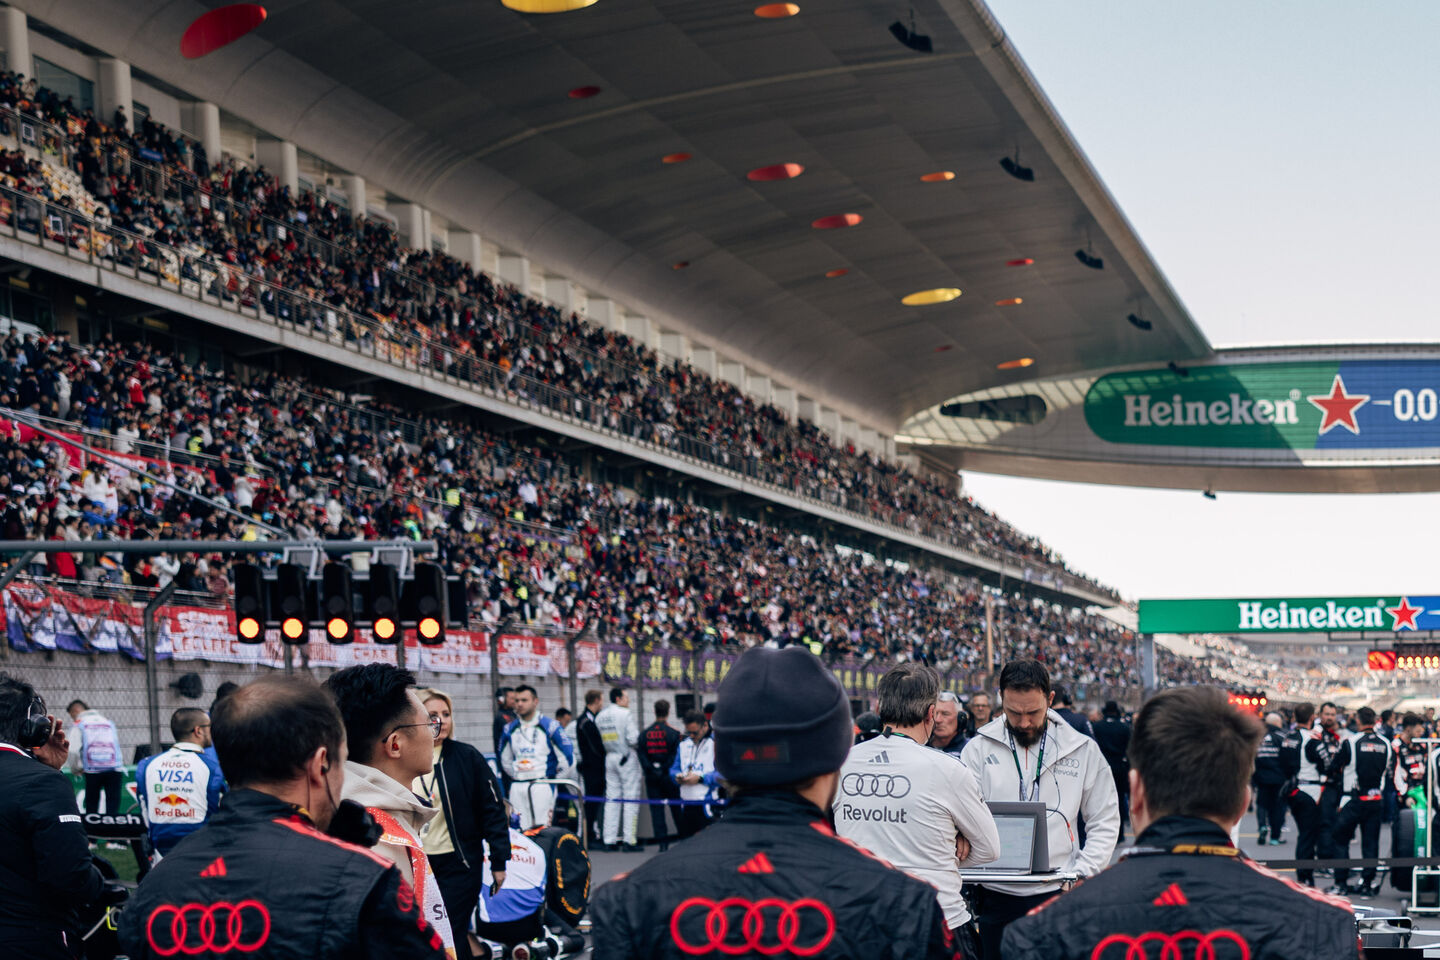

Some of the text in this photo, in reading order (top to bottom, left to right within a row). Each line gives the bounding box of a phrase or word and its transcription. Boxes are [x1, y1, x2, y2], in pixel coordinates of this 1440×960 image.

[1123, 393, 1299, 426] Heineken
[1394, 388, 1438, 422] 0.0
[1238, 600, 1384, 629] Heineken
[161, 761, 191, 769] HUGO
[158, 769, 194, 784] VISA
[85, 813, 140, 825] Cash
[155, 807, 195, 818] Red Bull
[843, 804, 907, 824] Revolut
